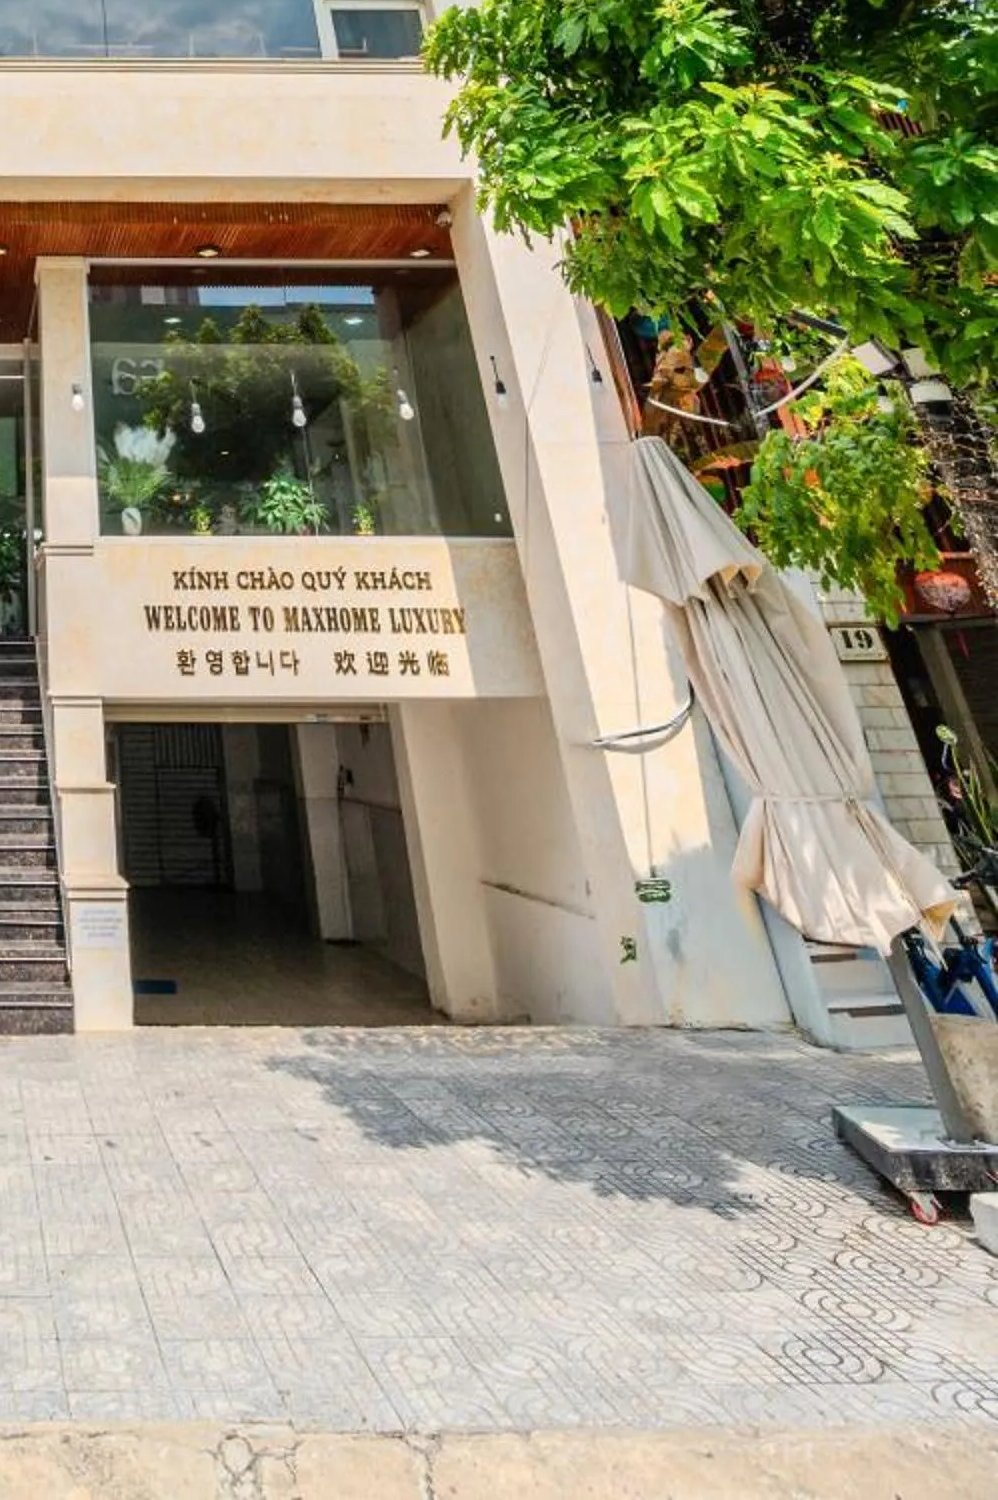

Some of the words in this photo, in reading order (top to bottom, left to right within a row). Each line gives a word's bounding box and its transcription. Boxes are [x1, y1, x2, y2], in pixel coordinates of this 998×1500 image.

[172, 566, 229, 590] KÍNH
[236, 566, 295, 590] CHÀO
[301, 565, 347, 592] QUÝ
[354, 567, 433, 591] KHÁCH
[143, 605, 241, 631] WELCOME
[248, 606, 275, 632] TO
[283, 606, 382, 633] MAXHOME
[388, 607, 467, 634] LUXURY
[838, 630, 873, 649] 19
[176, 649, 300, 676] 환영합니다
